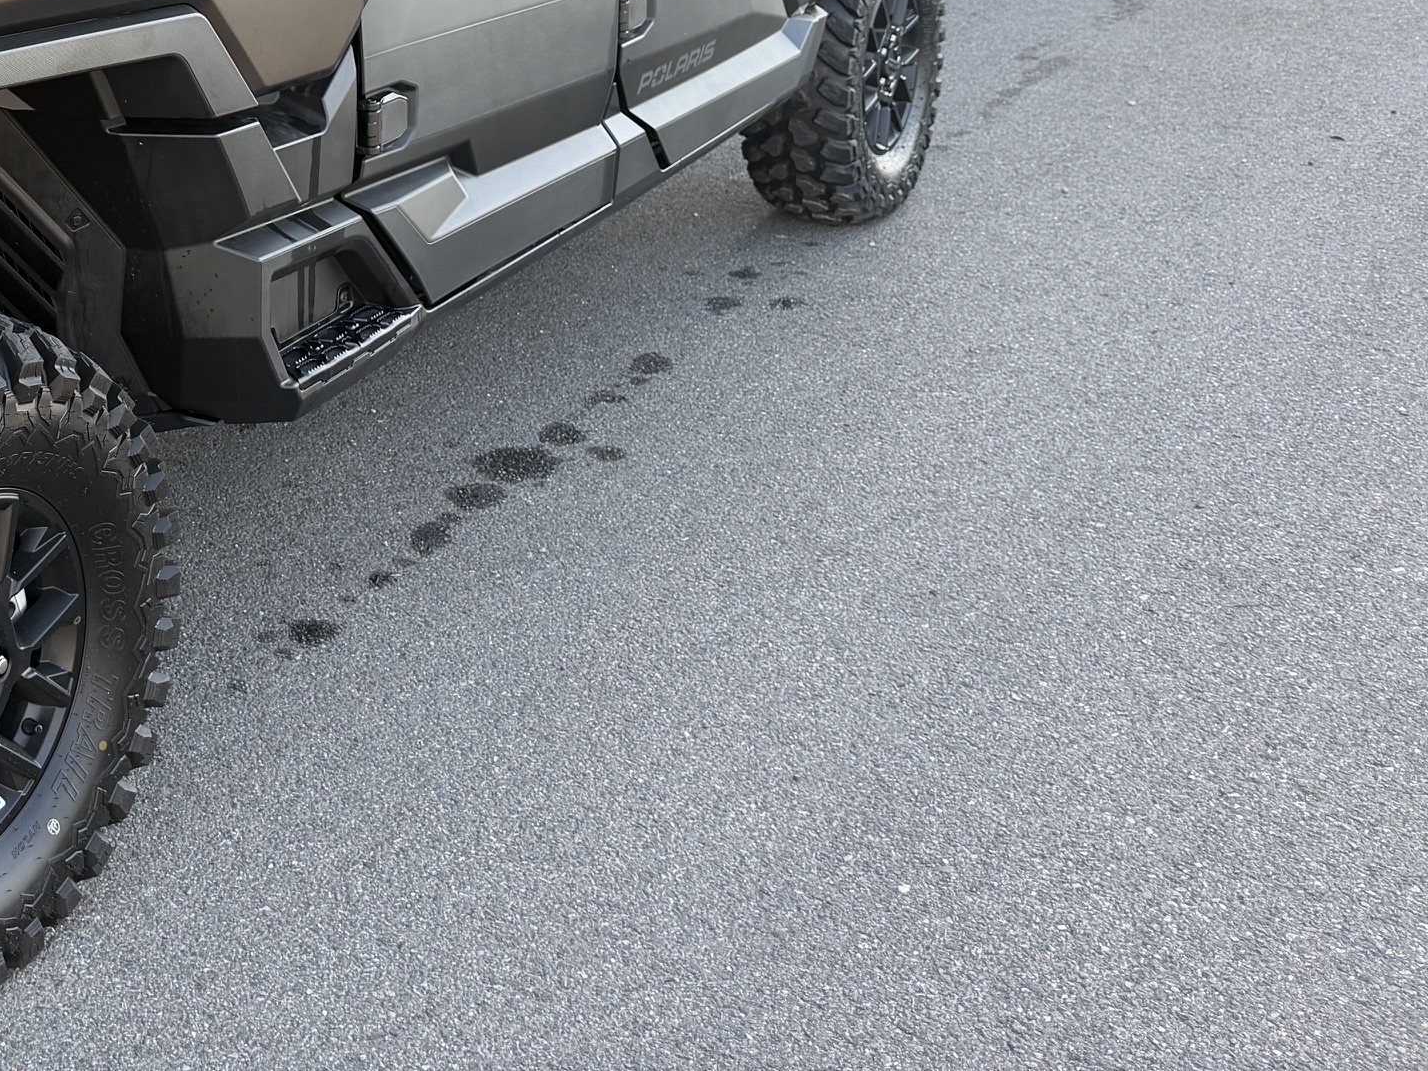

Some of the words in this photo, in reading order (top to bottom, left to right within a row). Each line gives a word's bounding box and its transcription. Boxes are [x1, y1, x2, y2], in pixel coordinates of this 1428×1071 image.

[636, 39, 717, 96] POLARIS
[87, 521, 127, 651] CROSS
[51, 674, 119, 802] TRAIL
